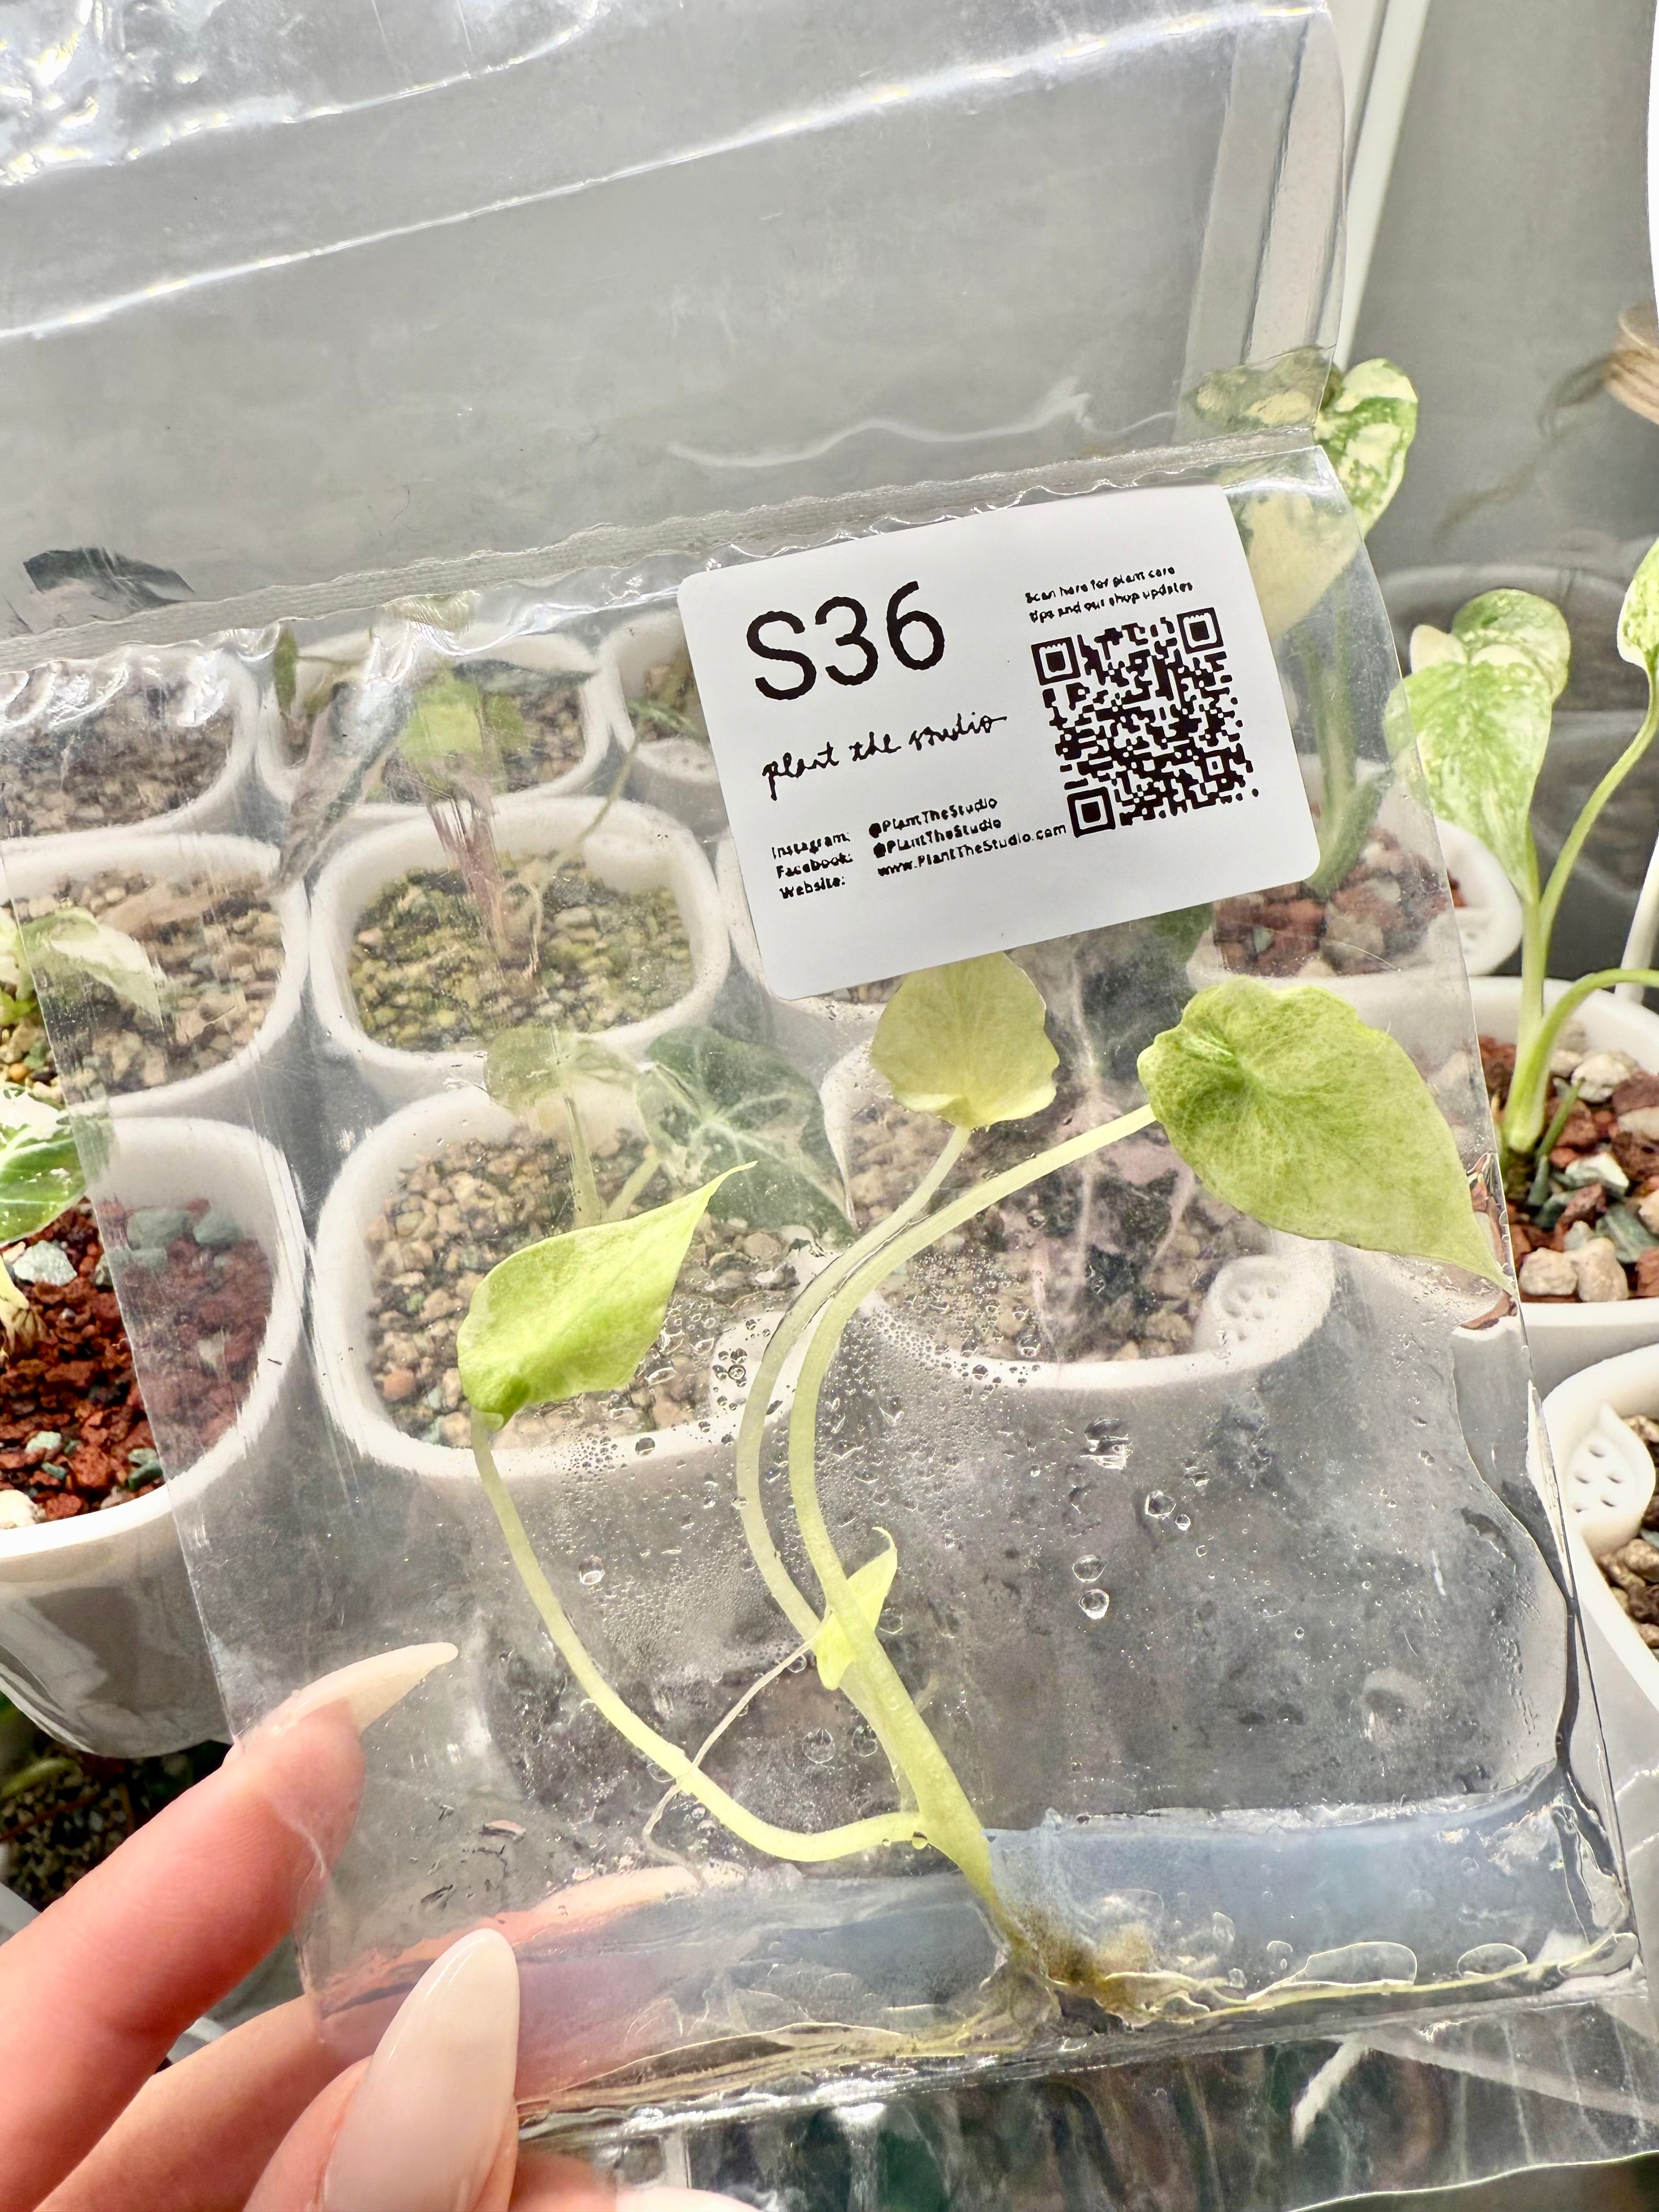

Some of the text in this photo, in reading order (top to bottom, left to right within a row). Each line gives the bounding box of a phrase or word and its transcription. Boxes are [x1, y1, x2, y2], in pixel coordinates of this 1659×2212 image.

[1025, 590, 1056, 603] Scan
[1090, 578, 1108, 590] for
[1058, 601, 1082, 617] and
[1084, 599, 1105, 611] our
[746, 580, 945, 701] S36
[762, 711, 1007, 800] plant the studio
[776, 852, 853, 879] Facebook:
[779, 824, 1066, 899] Website: www.PlantTheStudio.com
